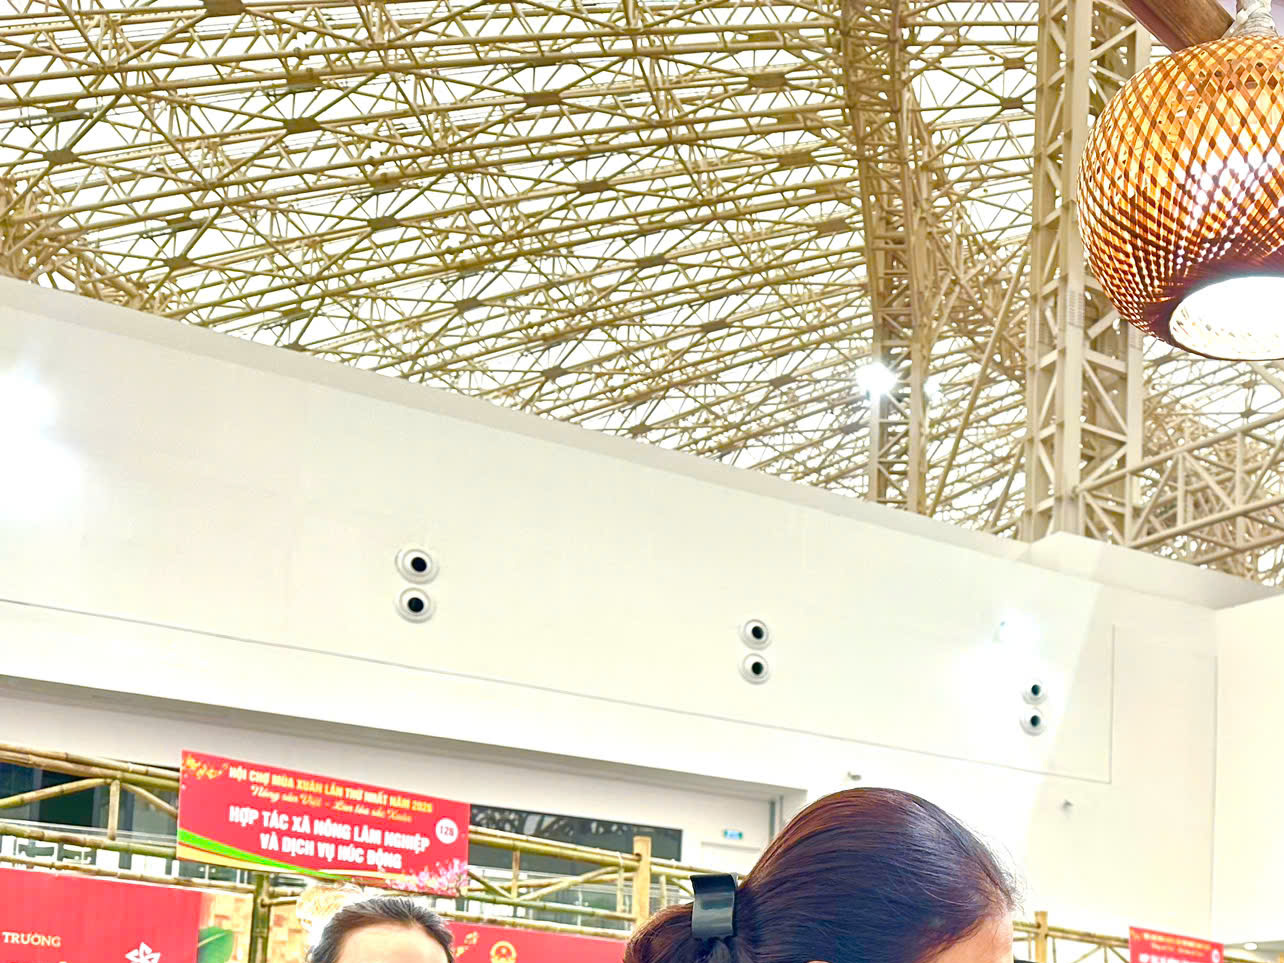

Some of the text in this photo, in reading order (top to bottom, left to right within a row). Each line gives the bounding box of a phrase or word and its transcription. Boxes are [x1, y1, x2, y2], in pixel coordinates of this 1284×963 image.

[229, 805, 430, 854] HỢP TÁC XÃ NÔNG LÂM NGHIỆP
[260, 831, 279, 851] VÀ
[281, 836, 315, 857] DỊCH
[317, 841, 336, 862] VỤ
